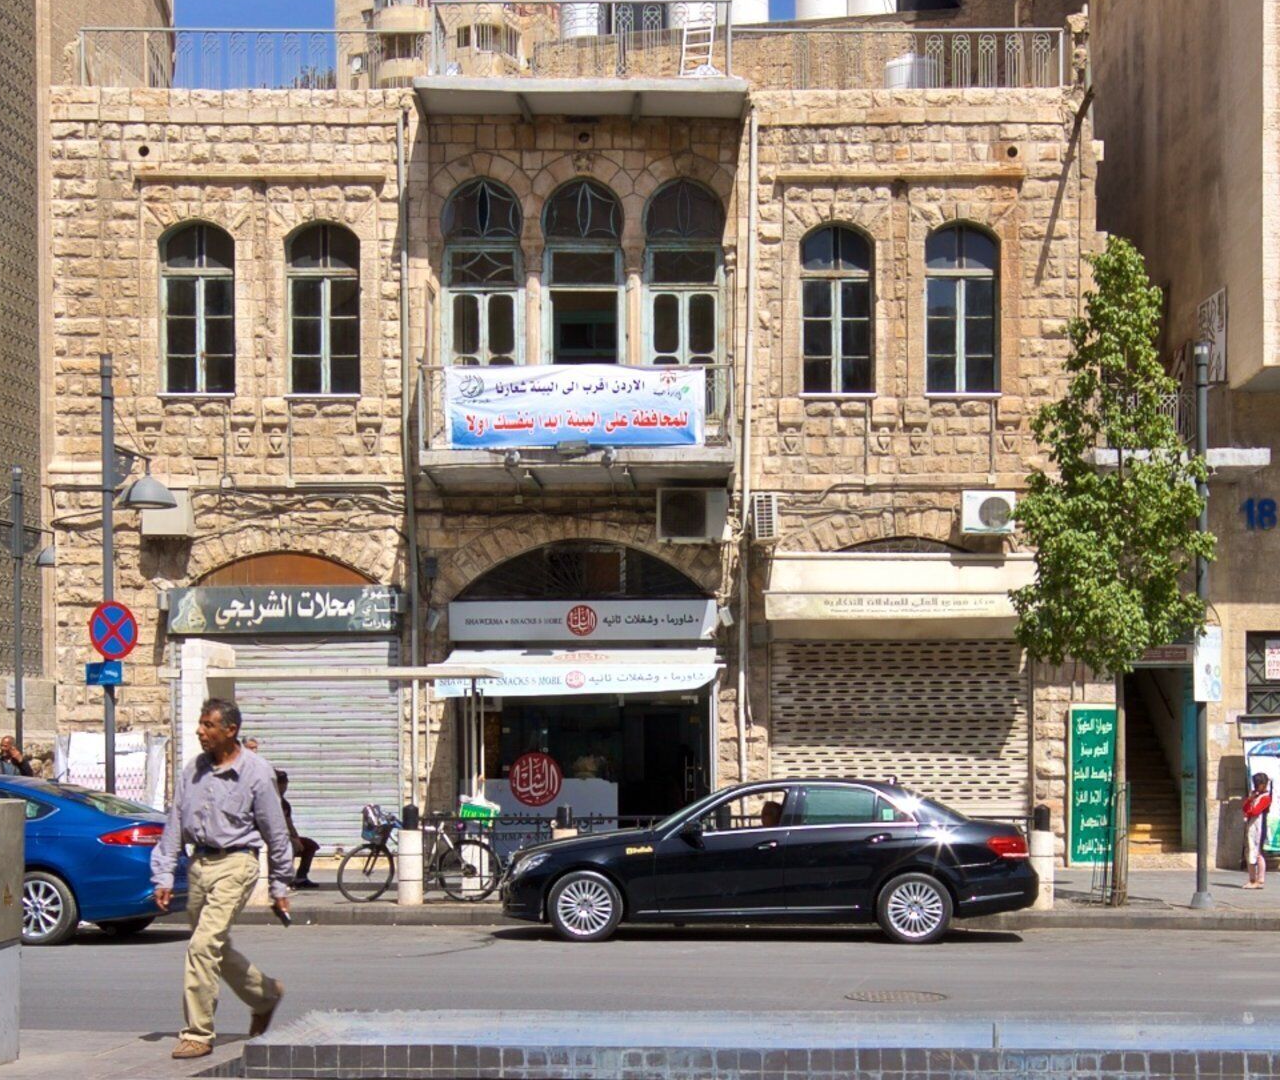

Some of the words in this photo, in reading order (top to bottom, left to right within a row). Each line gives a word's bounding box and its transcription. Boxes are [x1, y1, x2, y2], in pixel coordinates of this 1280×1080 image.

[605, 412, 628, 433] على
[632, 408, 689, 429] للمحافظة
[1242, 497, 1278, 531] 18
[214, 590, 293, 629] الشربجي
[296, 591, 357, 619] محلات
[666, 613, 694, 626] شاورما
